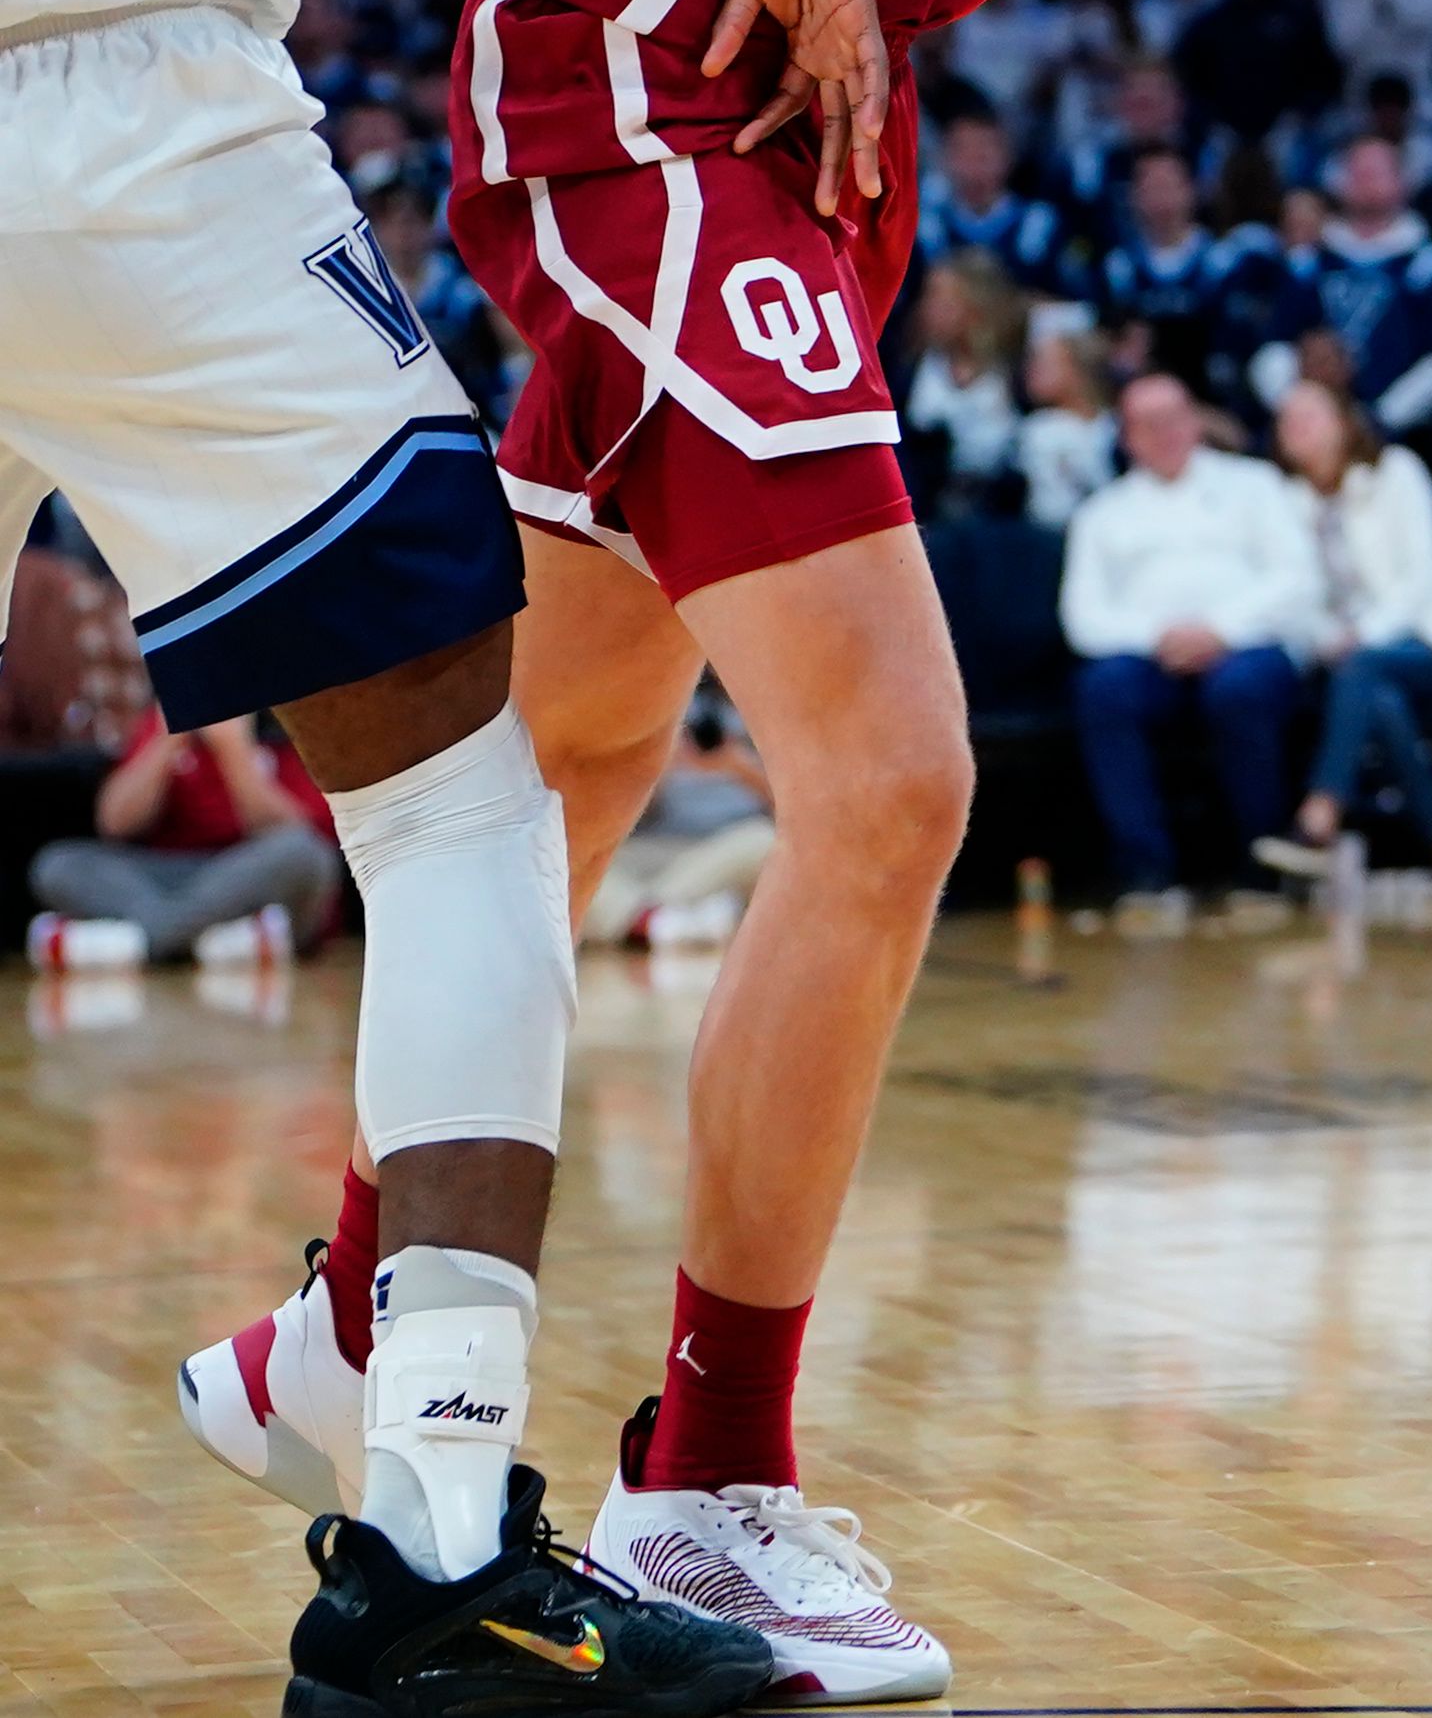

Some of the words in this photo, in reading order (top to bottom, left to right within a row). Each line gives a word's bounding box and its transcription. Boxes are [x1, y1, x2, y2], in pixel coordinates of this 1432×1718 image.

[302, 214, 431, 370] V
[720, 257, 862, 394] OU
[416, 1389, 510, 1426] ZAMST
